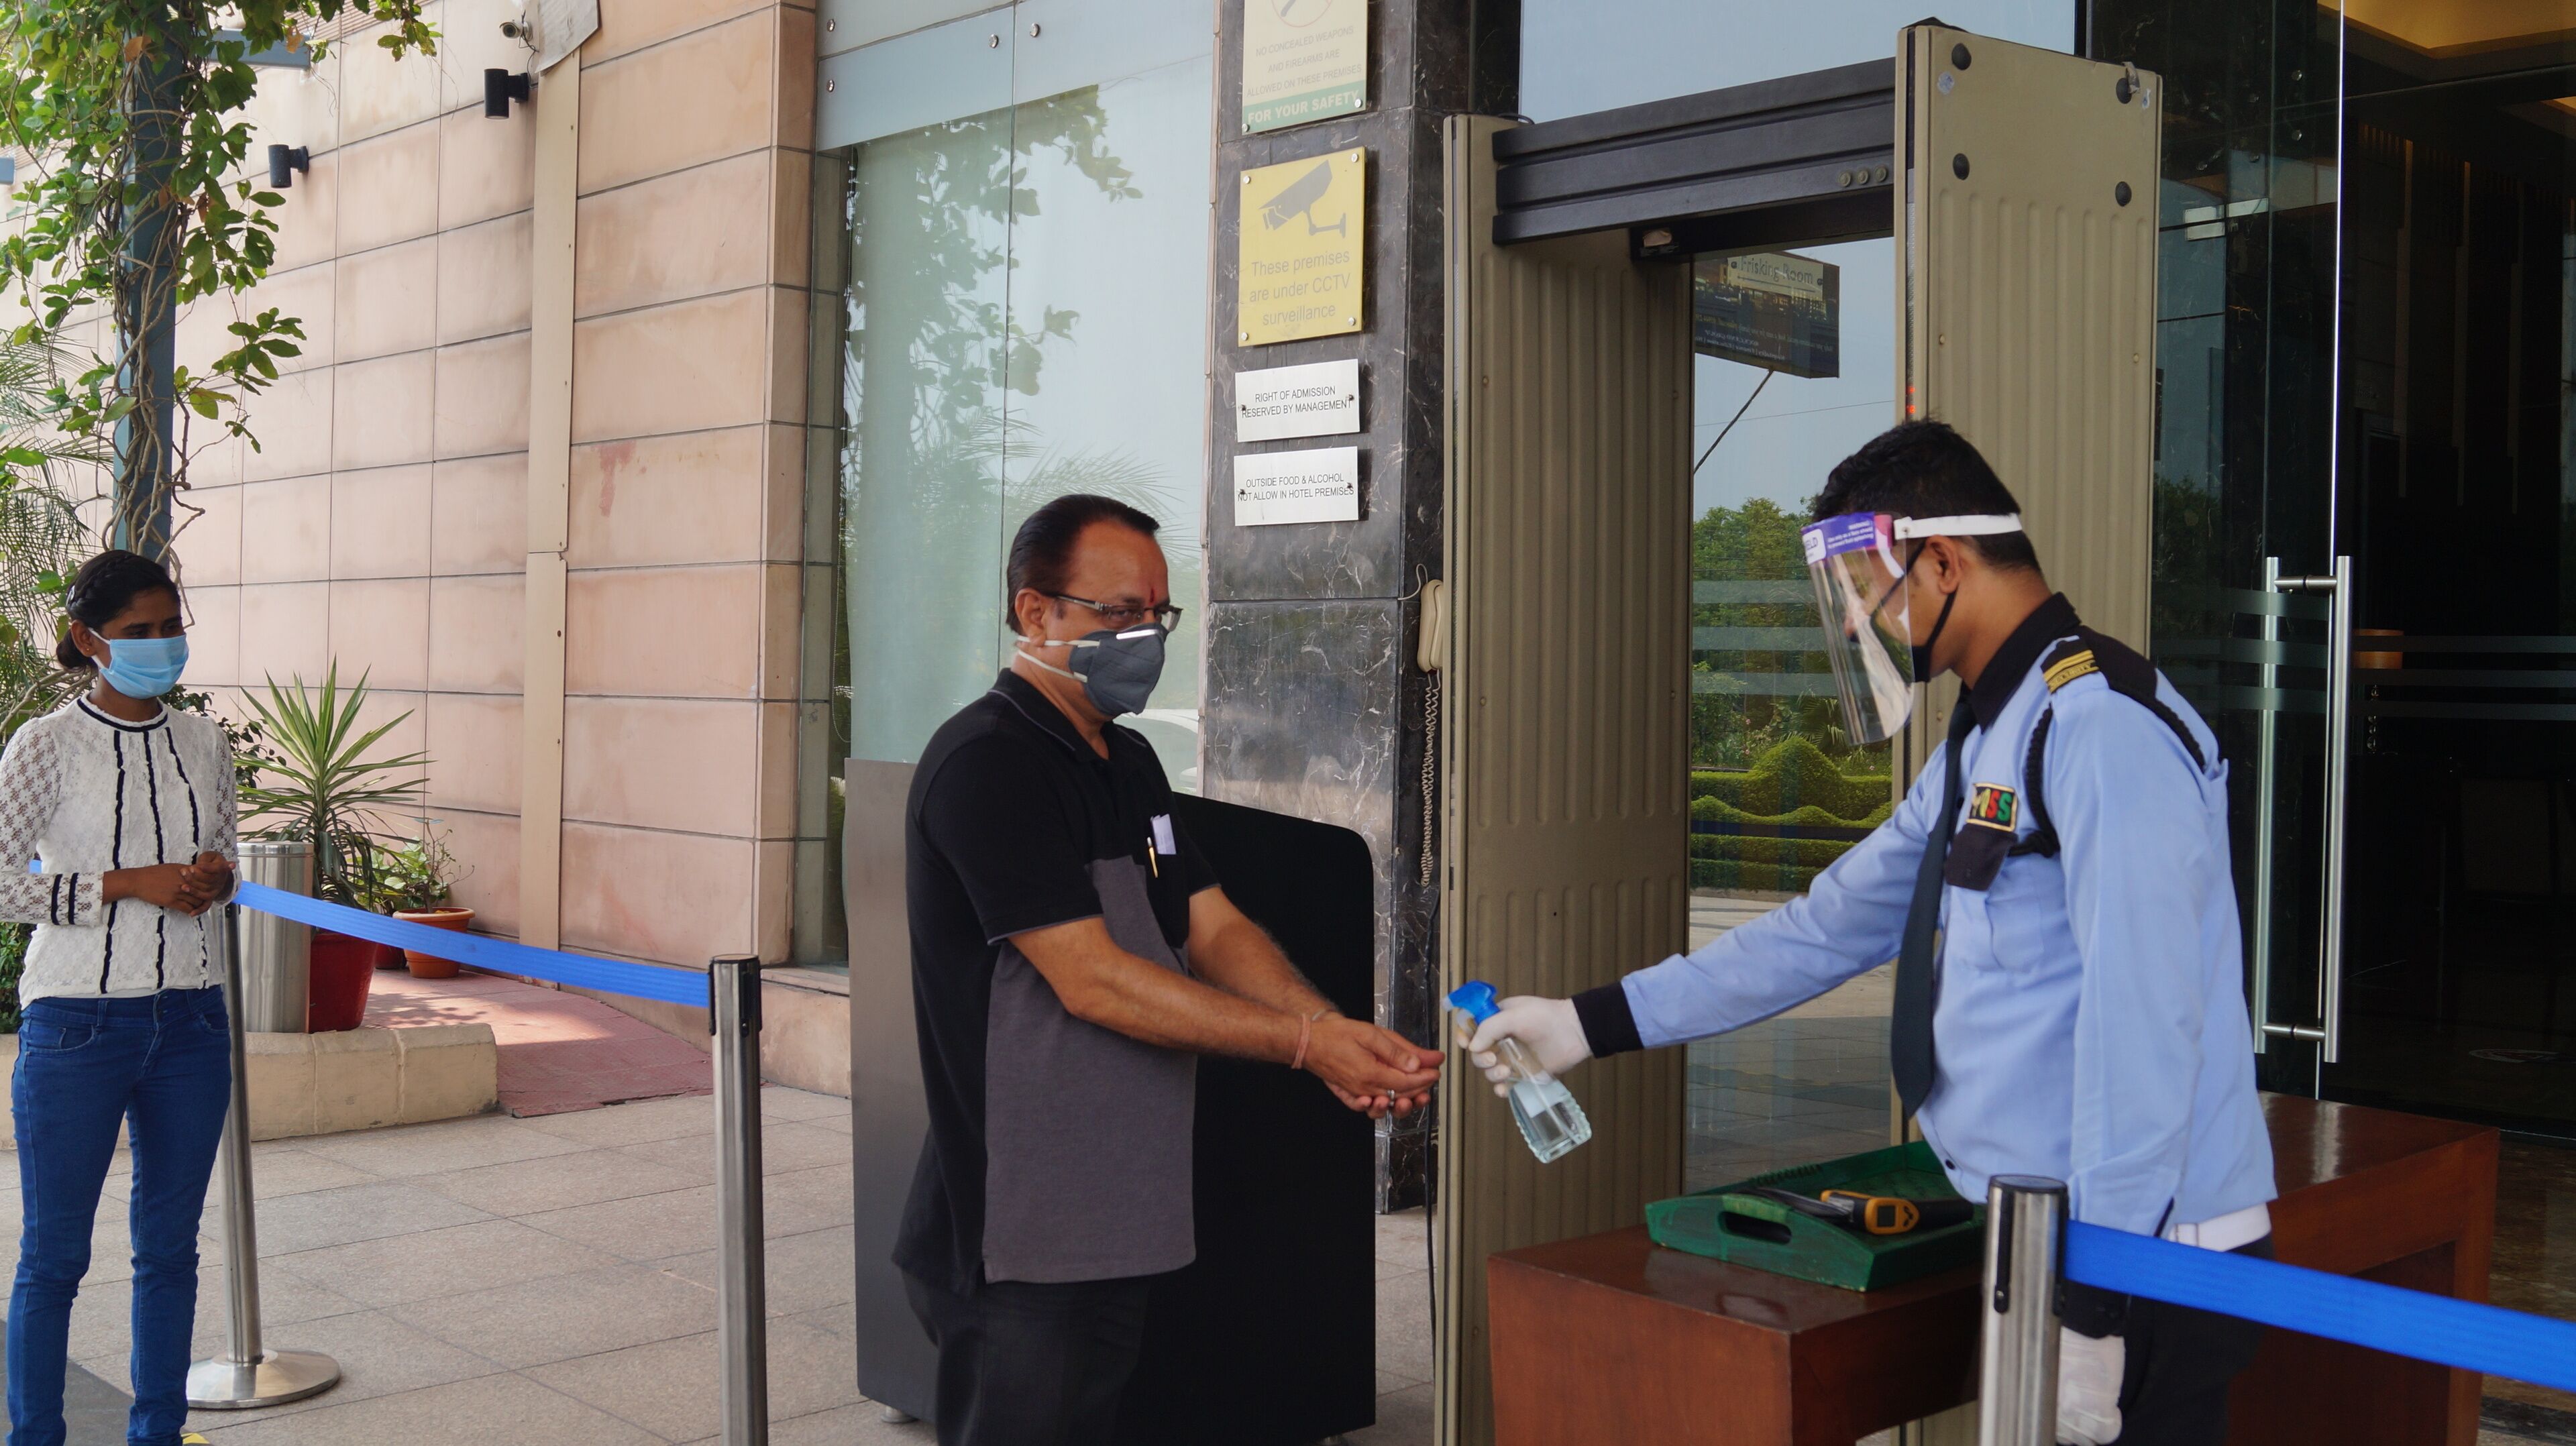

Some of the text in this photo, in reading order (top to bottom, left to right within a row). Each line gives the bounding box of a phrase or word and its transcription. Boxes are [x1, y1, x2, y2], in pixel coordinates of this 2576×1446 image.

[1256, 25, 1354, 57] NO CONCEALED WEAPONS
[1267, 48, 1340, 74] AND FIREARMS ARE
[1246, 64, 1362, 97] ALLOWED ON THESE PREMISES
[1248, 90, 1360, 124] FOR YOUR SAFETY
[1251, 250, 1350, 277] These premises
[1741, 256, 1813, 284] Frisking Room
[1249, 273, 1350, 302] are under CCTV
[1263, 304, 1336, 326] surveillance
[1255, 386, 1336, 402] RIGHT OF ADMISSION
[1242, 405, 1281, 419] RESERVED
[1283, 404, 1293, 414] BY
[1246, 473, 1344, 488] OUTSIDE FOOD & ALCOHOL
[1238, 486, 1354, 502] NOT ALLOW IN HOTEL PREMISES
